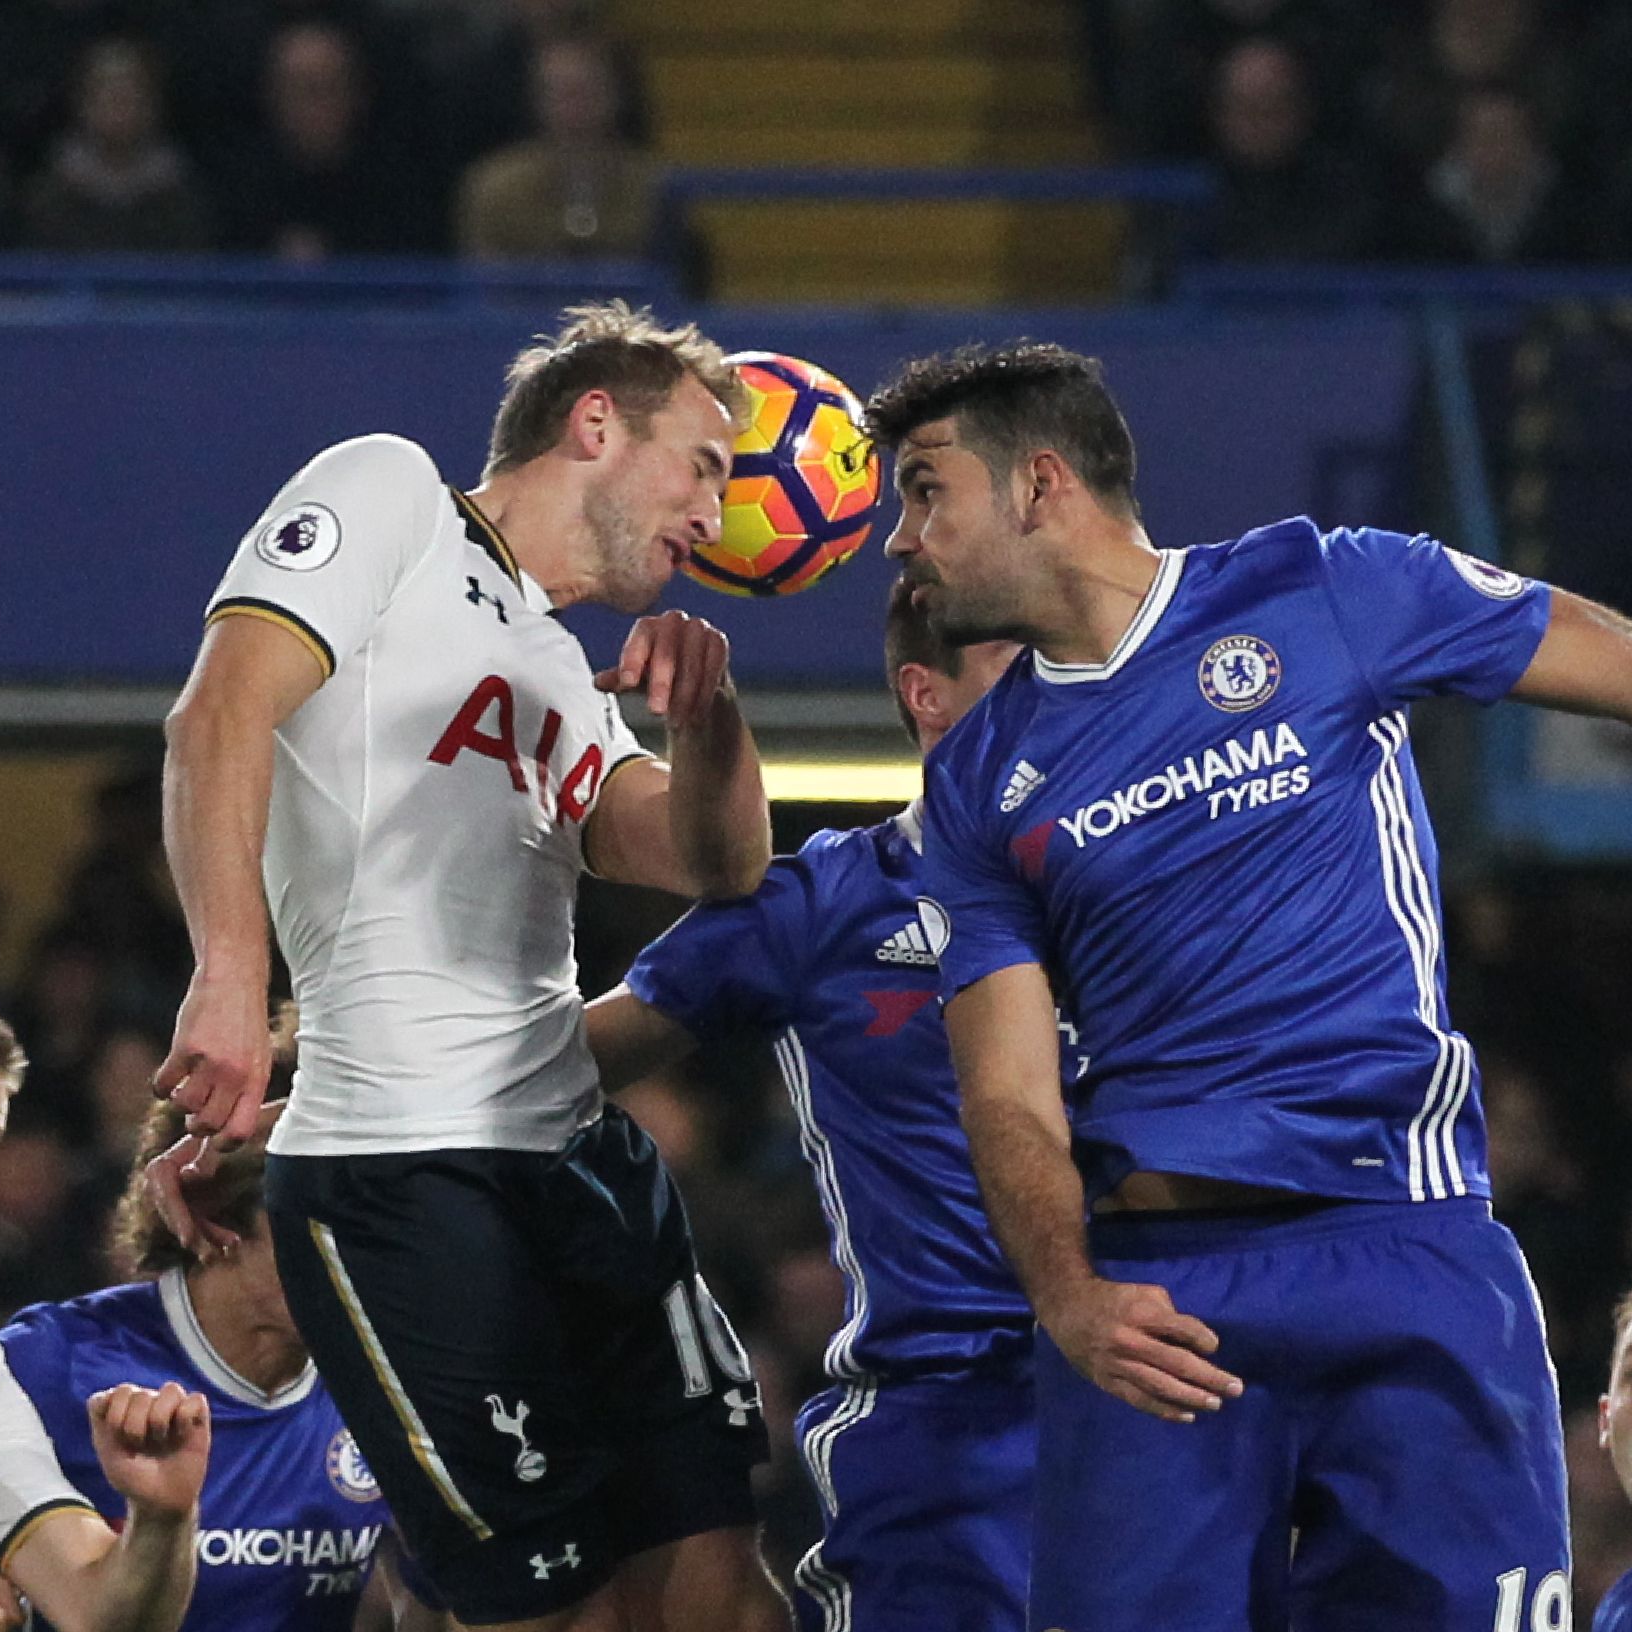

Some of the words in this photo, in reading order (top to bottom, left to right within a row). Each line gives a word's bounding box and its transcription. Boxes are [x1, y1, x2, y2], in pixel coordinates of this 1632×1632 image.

[426, 674, 604, 826] AIA
[1058, 723, 1308, 848] YOKOHAMA
[1208, 765, 1311, 820] TYRES
